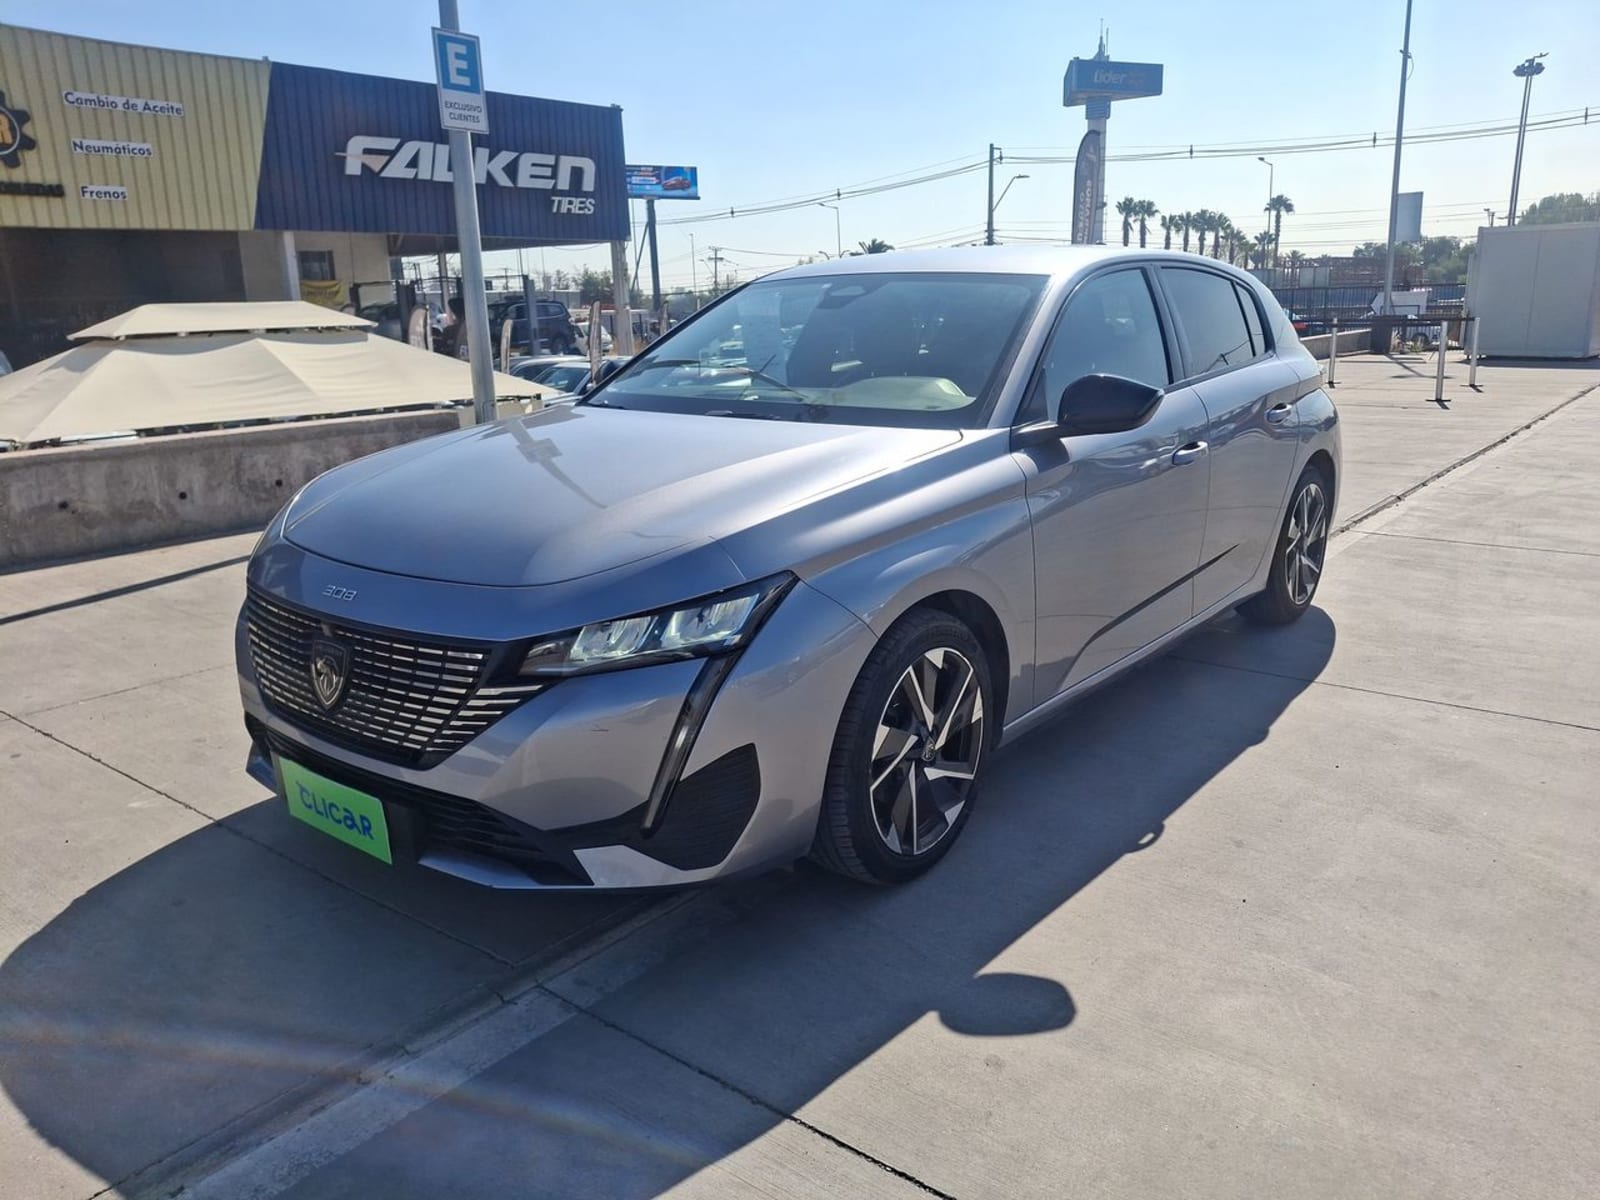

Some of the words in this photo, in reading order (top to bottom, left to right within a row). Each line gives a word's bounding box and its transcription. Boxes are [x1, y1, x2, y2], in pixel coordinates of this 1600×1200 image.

[446, 42, 471, 86] E
[64, 92, 118, 109] Cambio
[122, 99, 138, 111] de
[142, 101, 184, 115] Aceite
[445, 100, 482, 113] EXCLUSIVO
[449, 112, 480, 123] CLIENTES
[72, 141, 152, 156] Neumáticos
[344, 135, 596, 192] FALKEN
[81, 186, 127, 199] Frenos
[551, 196, 595, 214] TIRES
[322, 584, 357, 600] 308
